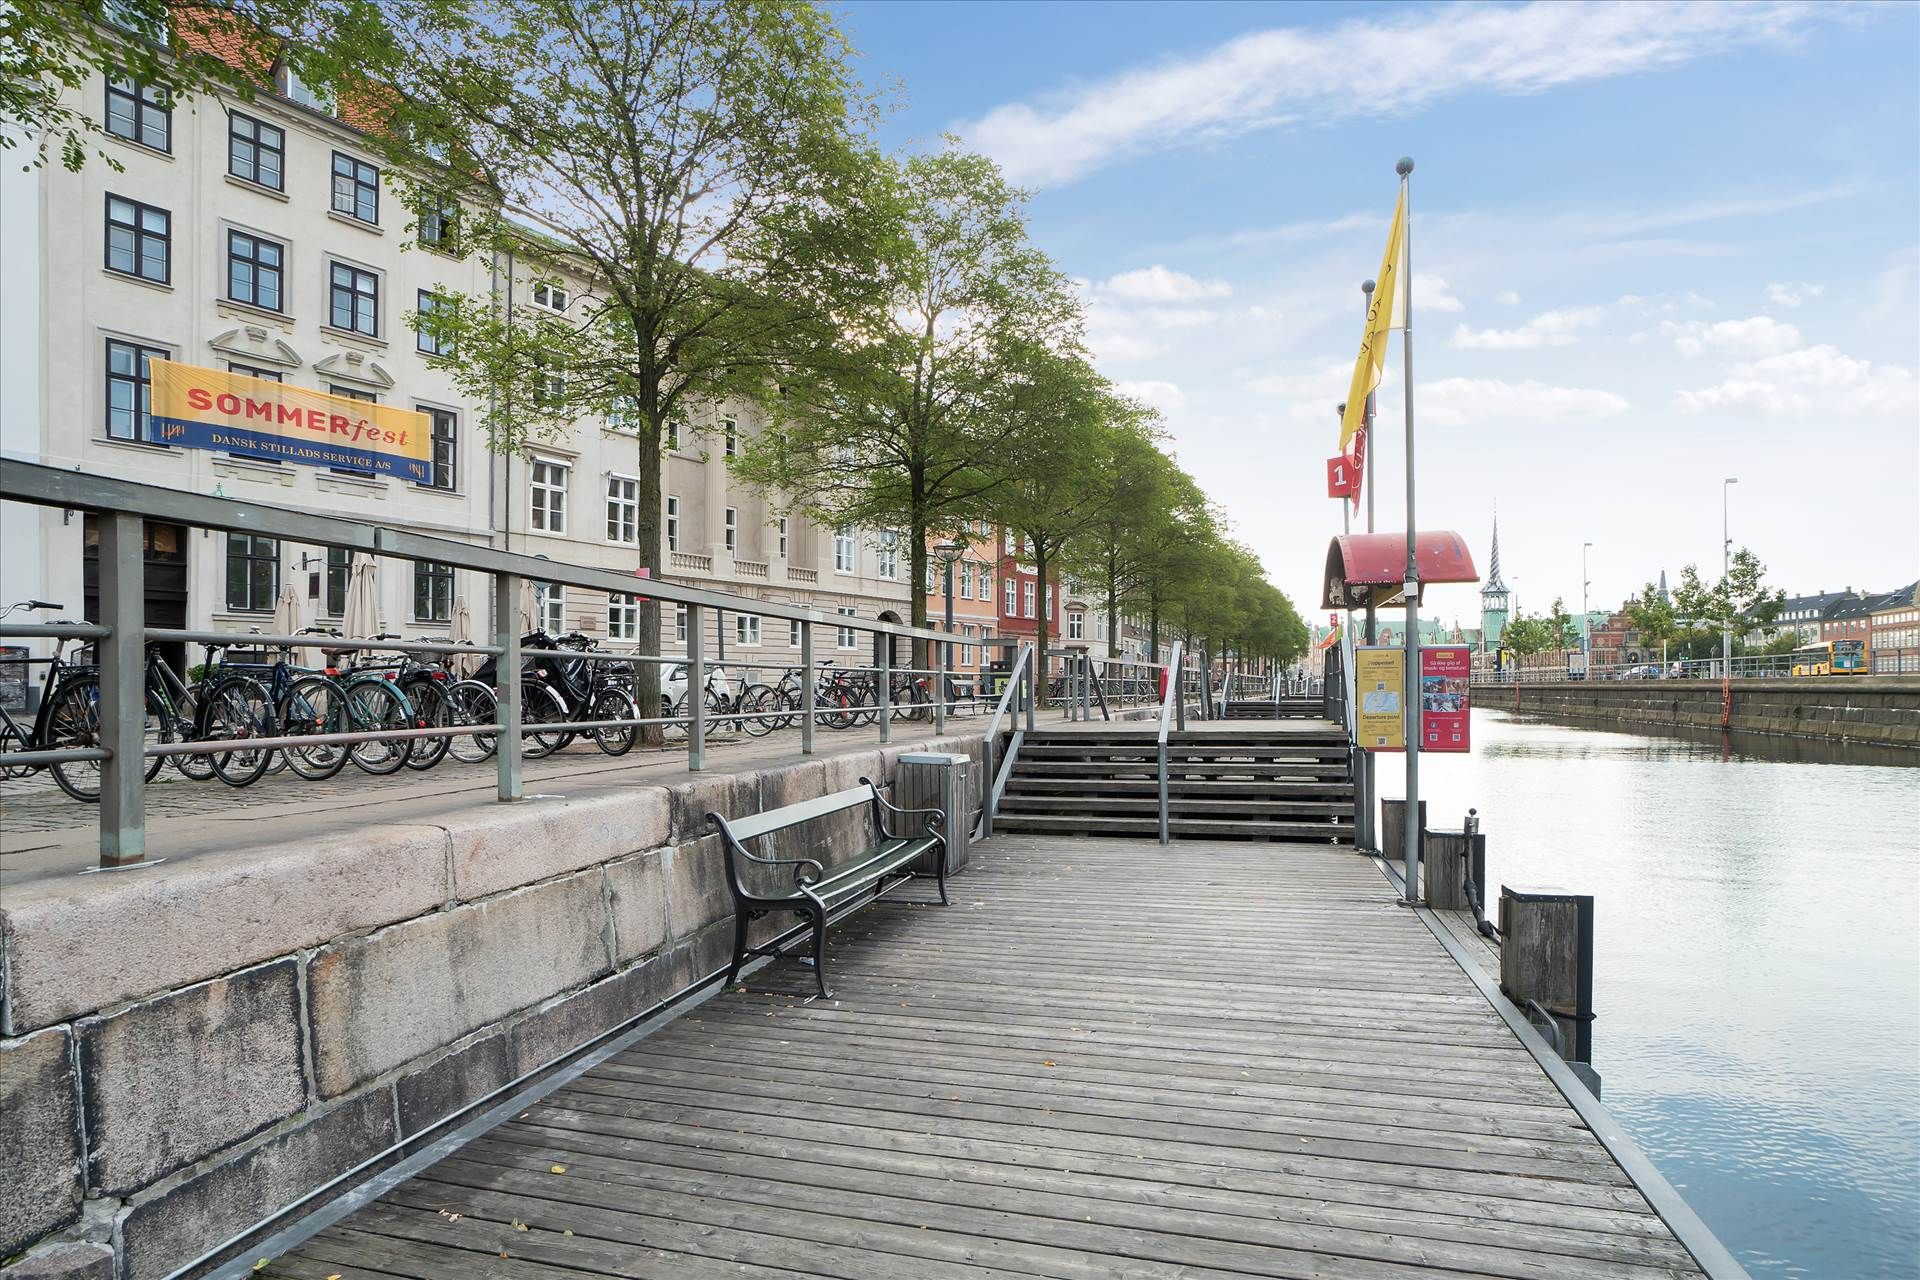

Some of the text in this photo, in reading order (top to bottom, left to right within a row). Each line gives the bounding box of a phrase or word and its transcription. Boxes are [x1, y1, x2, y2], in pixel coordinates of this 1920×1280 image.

[187, 388, 408, 446] SOMMERfest
[212, 434, 391, 470] DANSK STILLADS SERVICE A/S
[1334, 464, 1347, 486] 1
